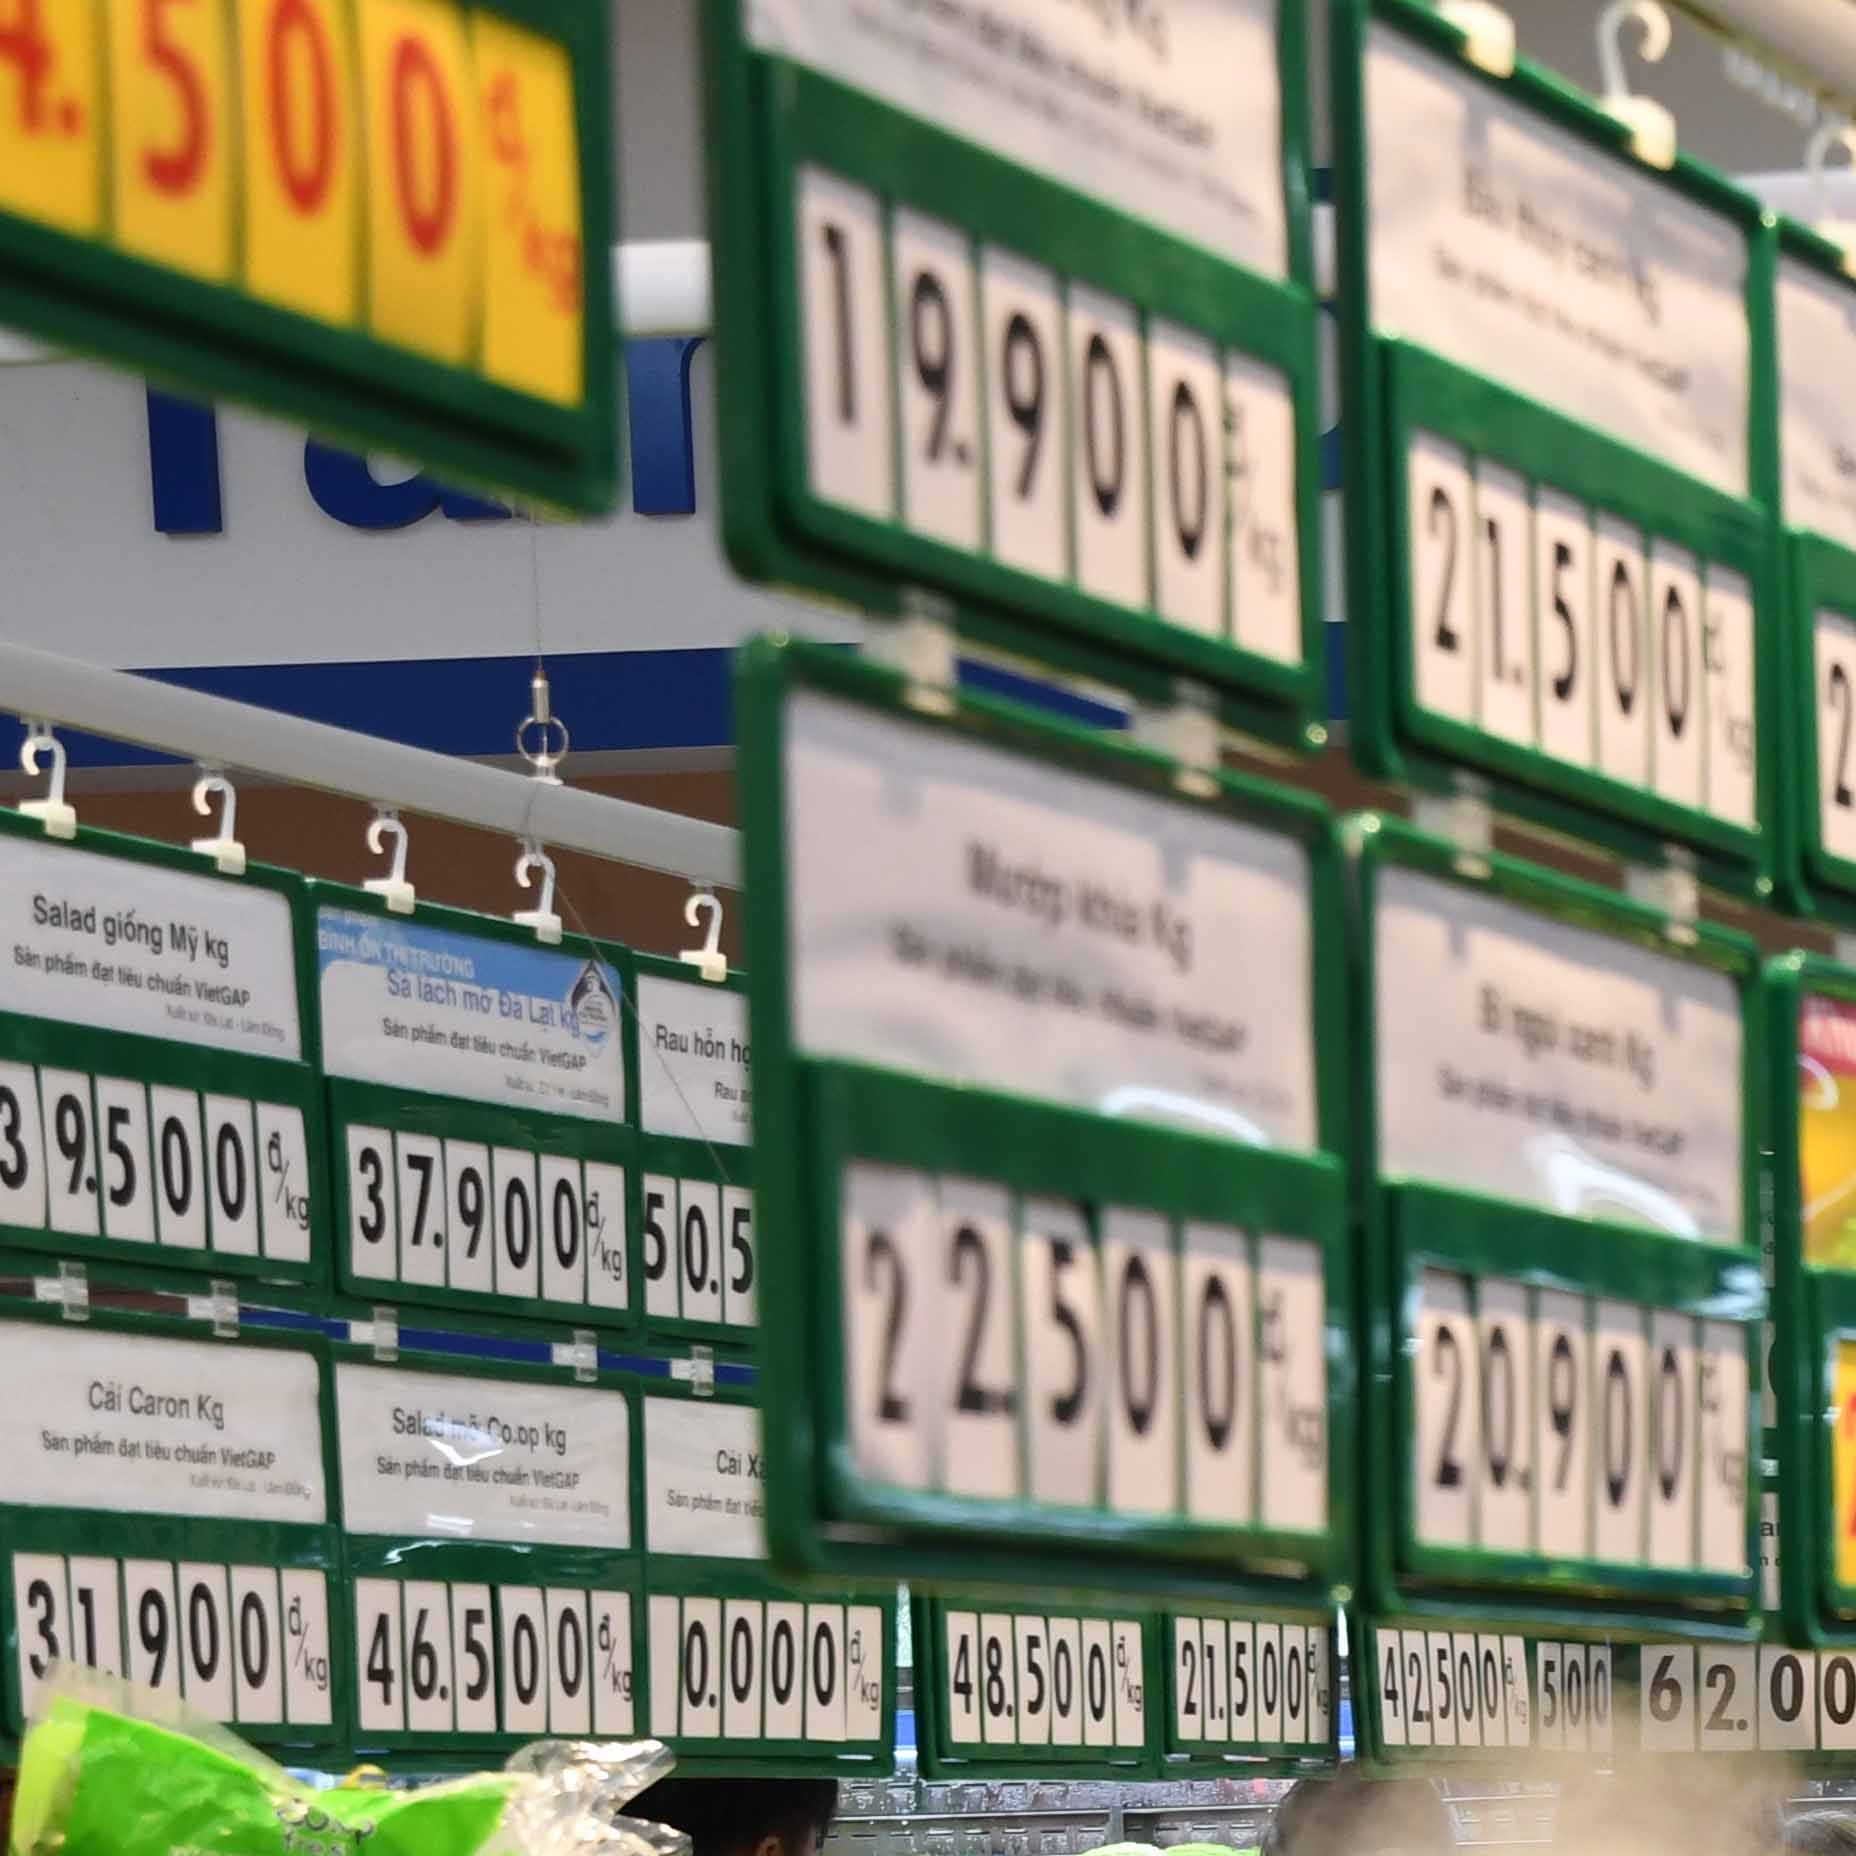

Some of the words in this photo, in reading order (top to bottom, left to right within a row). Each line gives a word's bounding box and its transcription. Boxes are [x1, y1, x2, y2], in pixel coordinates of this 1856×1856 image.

[820, 222, 1207, 561] 19.900
[1428, 488, 1688, 738] 21.500
[33, 894, 96, 935] Salad
[104, 909, 162, 954] giống
[206, 930, 229, 968] kg
[195, 981, 251, 1007] VietGAP
[656, 1023, 688, 1054] Rau
[0, 1086, 246, 1220] 39.500
[357, 1146, 577, 1270] 37.900
[129, 1386, 190, 1420] Caron
[198, 1394, 225, 1430] Kg
[545, 1423, 566, 1456] kg
[1432, 1325, 1685, 1508] 20.900
[289, 1594, 329, 1692] đ/kg
[367, 1607, 584, 1709] 46.500
[683, 1617, 838, 1709] 0.000
[848, 1630, 880, 1712] đ/kg
[952, 1632, 1106, 1722] 48.500
[1116, 1635, 1143, 1714] đ/kg
[1182, 1638, 1301, 1721] 21.500
